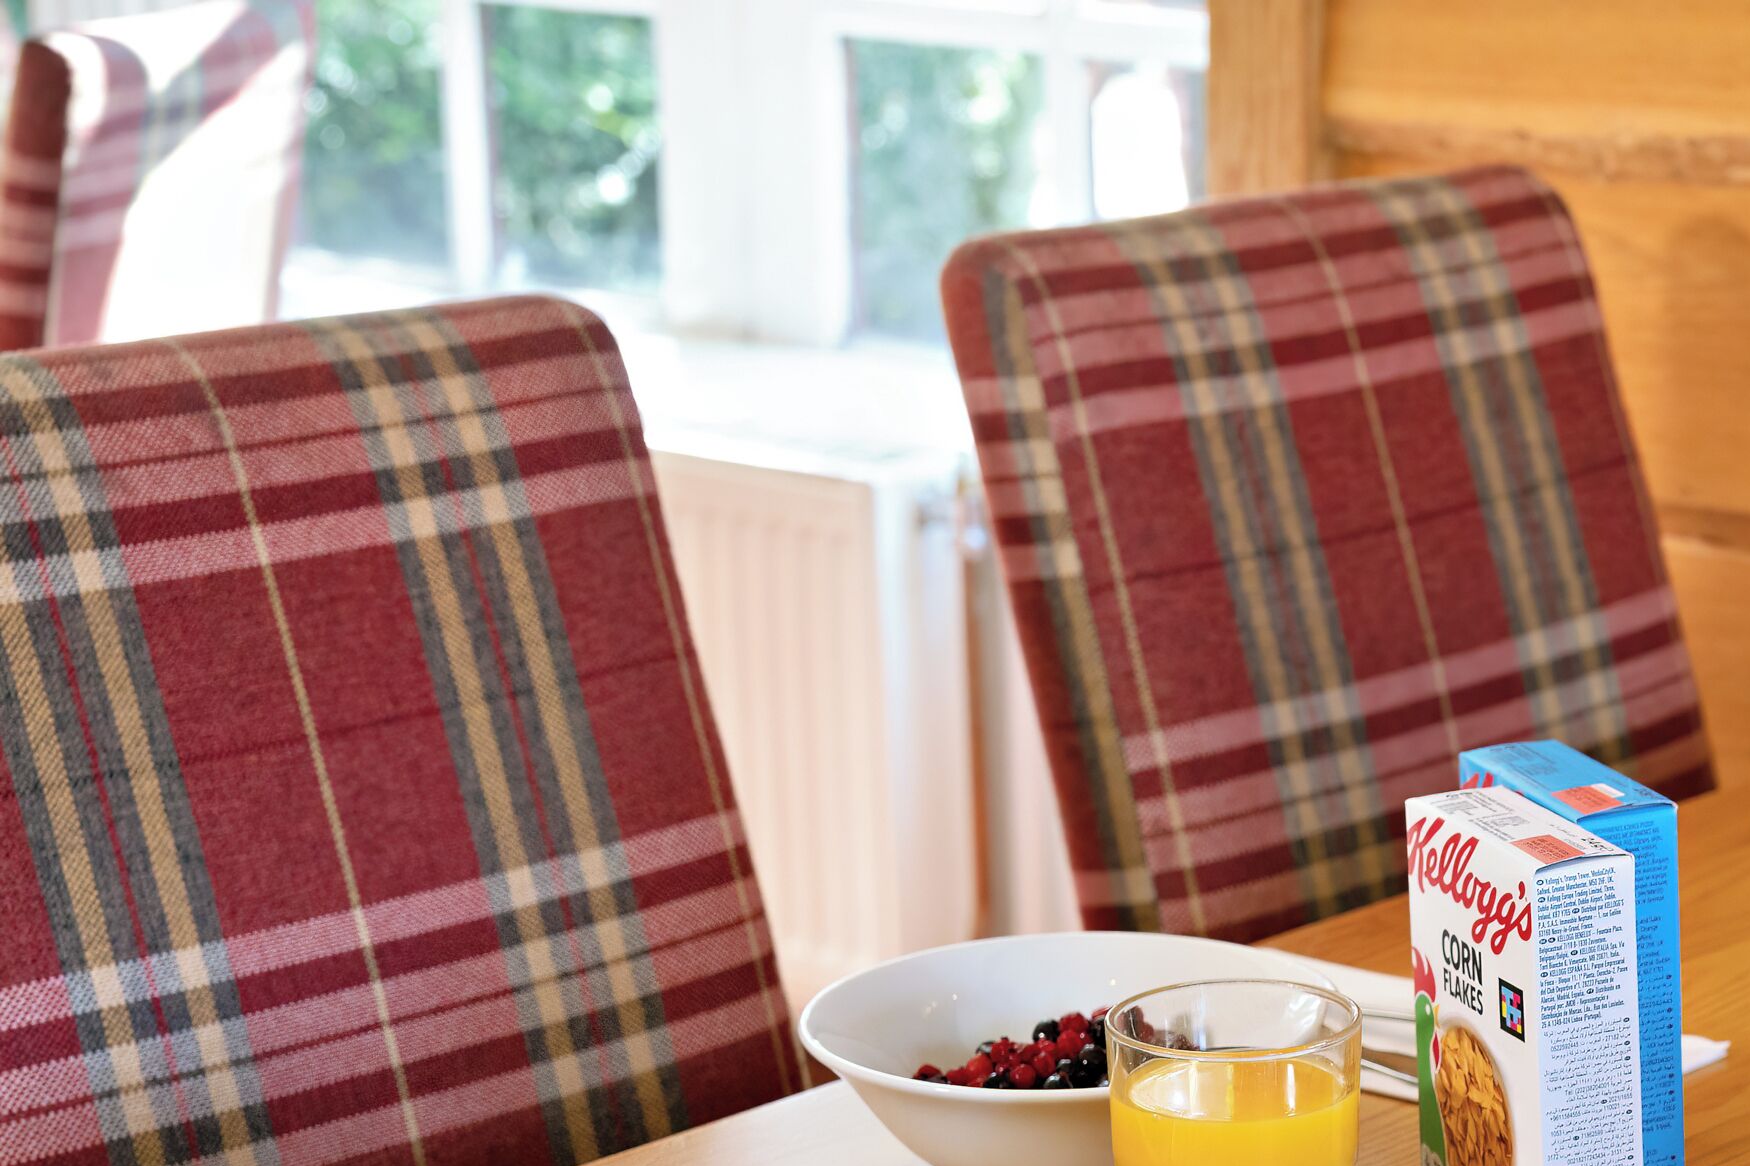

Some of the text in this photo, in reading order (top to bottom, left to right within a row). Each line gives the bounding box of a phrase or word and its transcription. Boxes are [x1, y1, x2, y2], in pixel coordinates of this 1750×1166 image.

[1407, 817, 1533, 955] Kellogg's
[1441, 928, 1483, 986] CORN
[1443, 967, 1484, 1016] FLAKES
